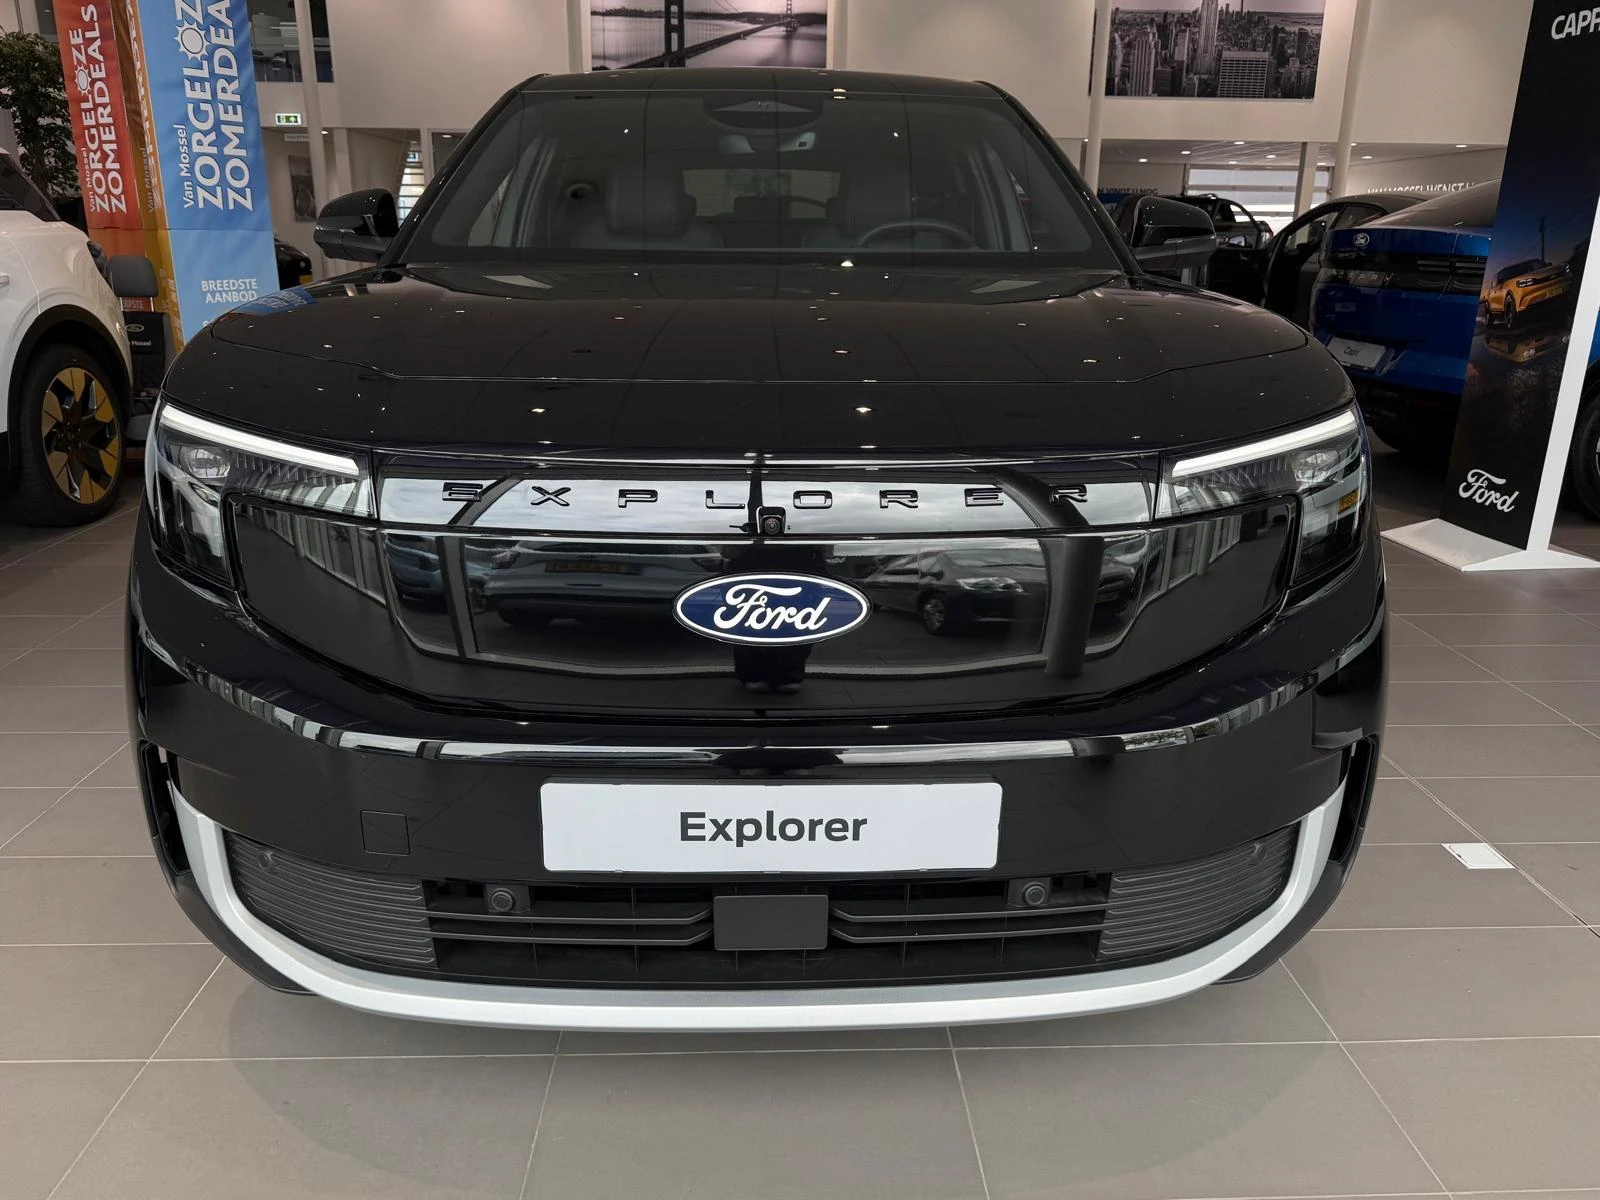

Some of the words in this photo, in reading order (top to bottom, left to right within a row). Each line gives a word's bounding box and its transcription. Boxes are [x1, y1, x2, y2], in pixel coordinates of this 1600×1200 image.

[81, 4, 127, 213] ZOMERDEALS
[173, 124, 191, 176] Mossel
[183, 181, 194, 208] Van
[201, 278, 258, 291] BREEDSTE
[205, 290, 257, 304] AANBOD
[442, 482, 1088, 509] EXPLORER
[1458, 469, 1519, 512] Ford
[713, 583, 831, 630] Ford
[679, 810, 868, 848] Explorer
